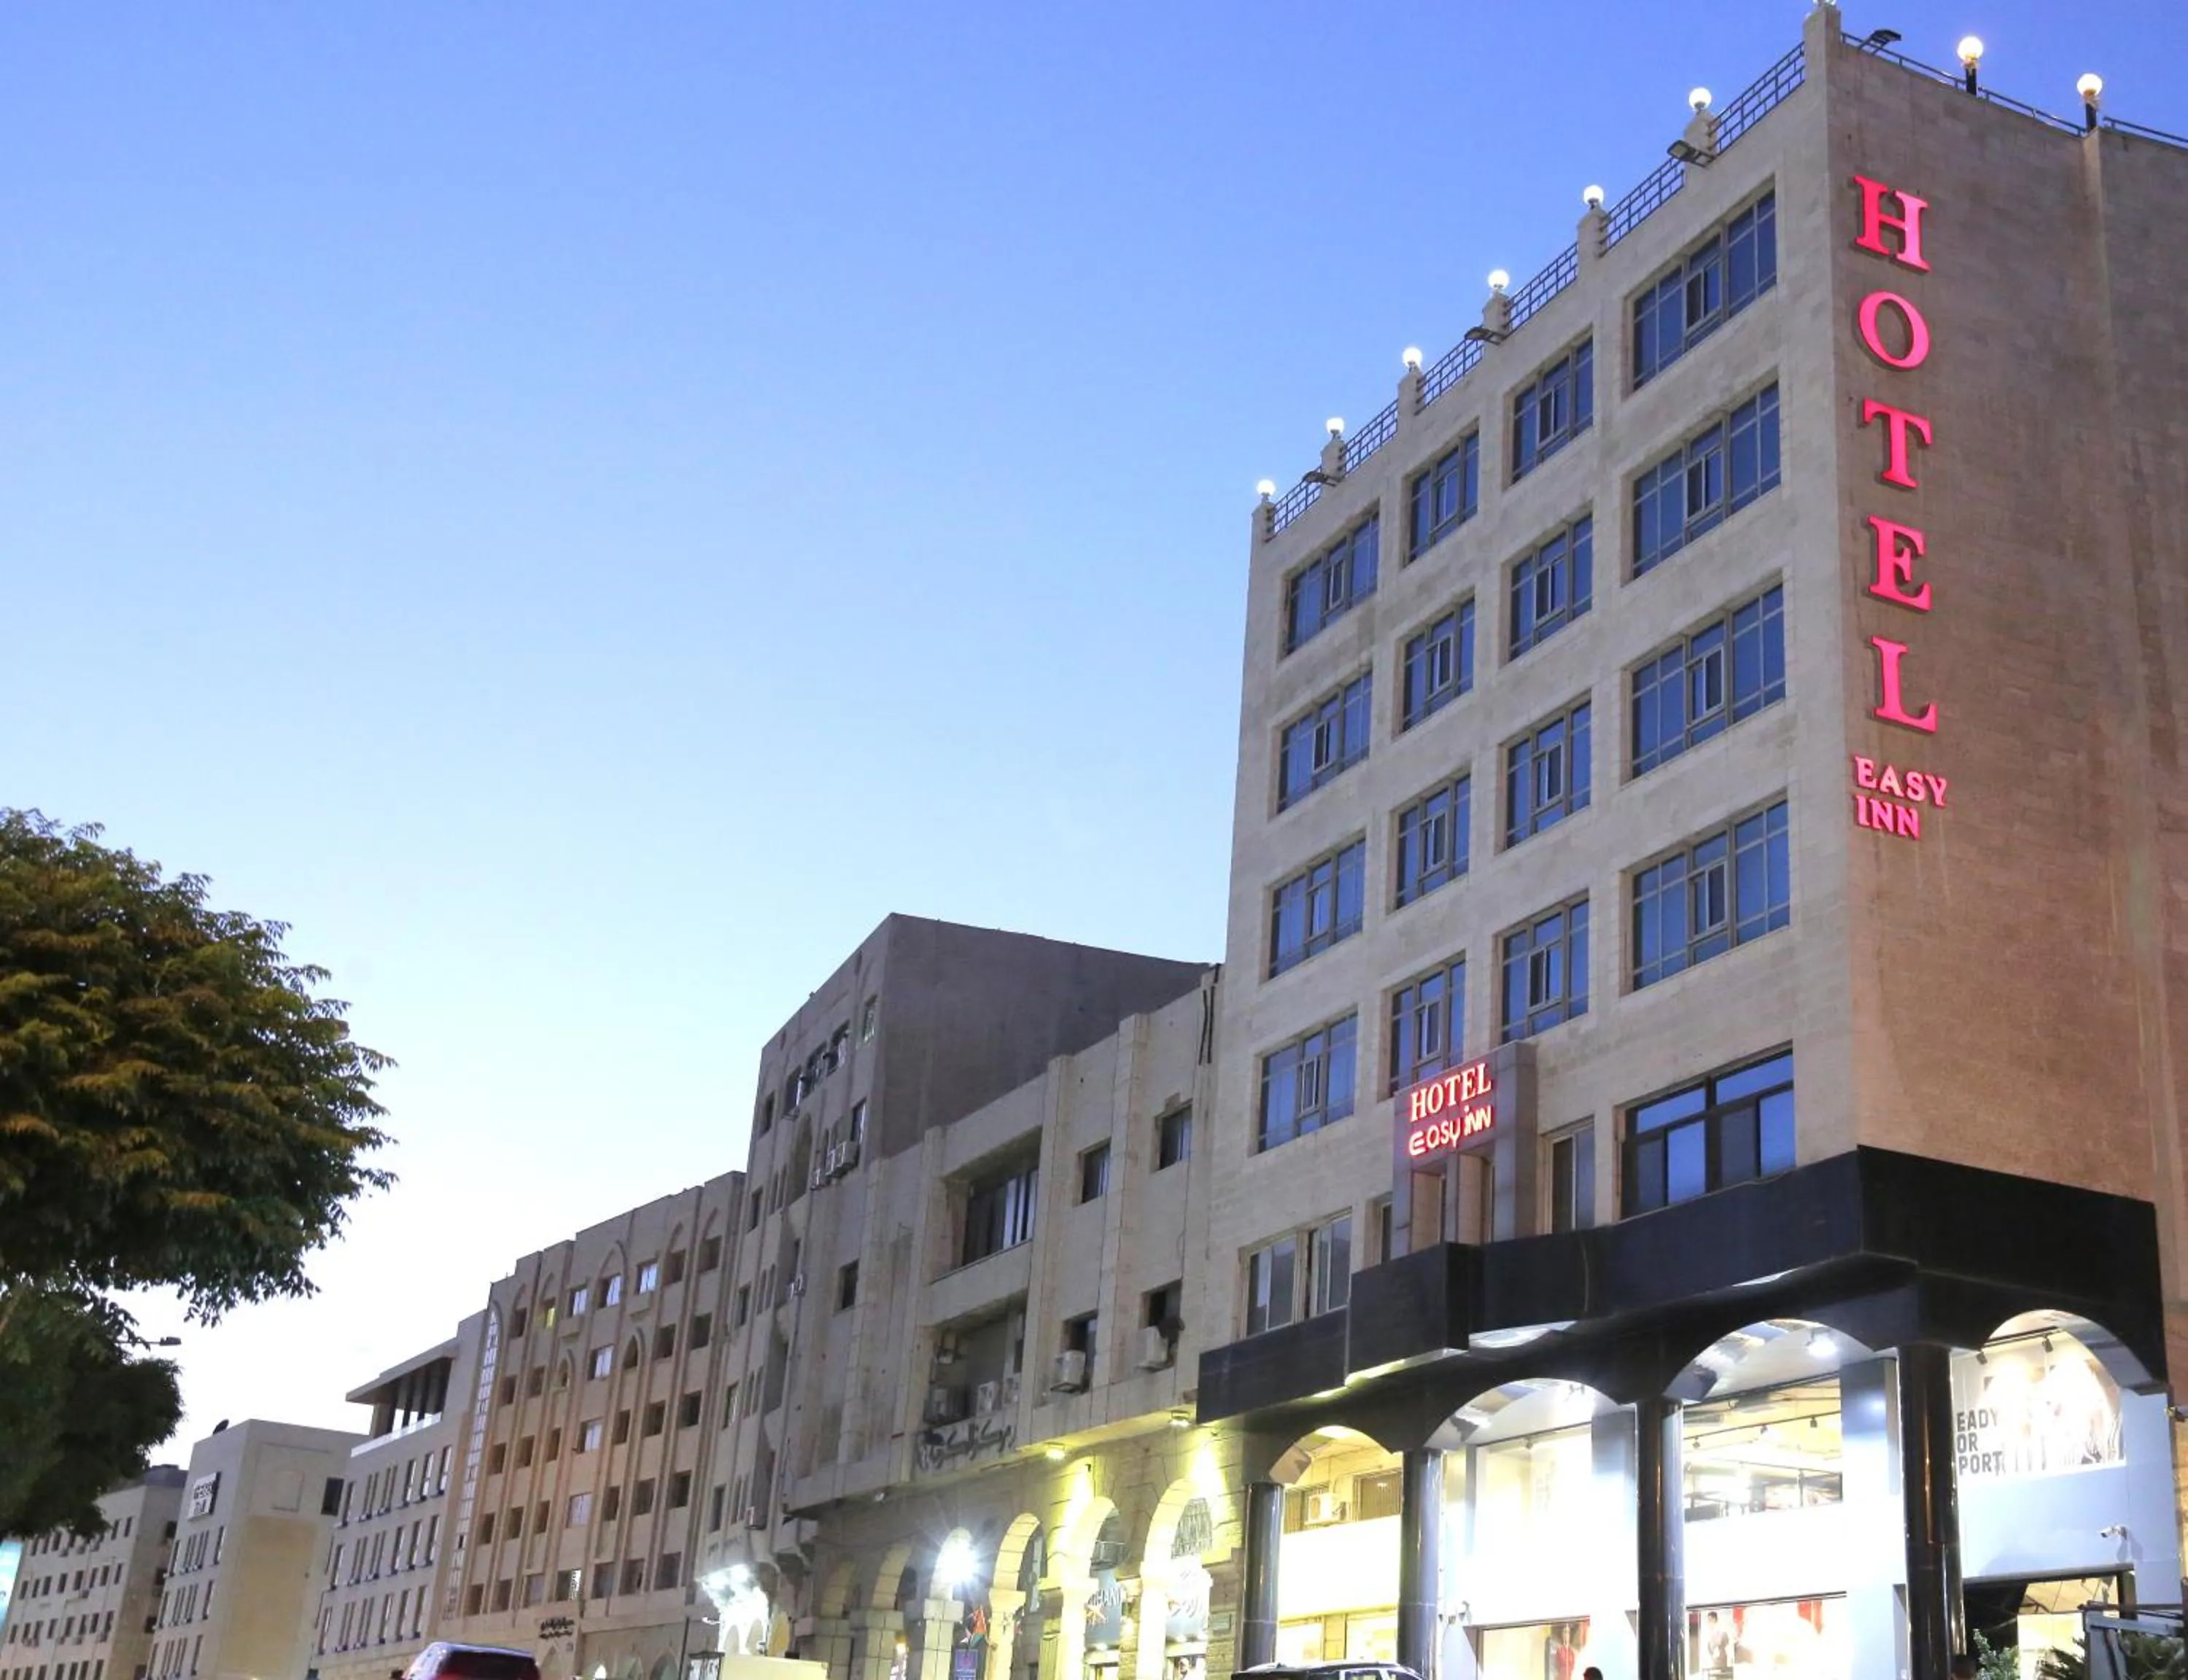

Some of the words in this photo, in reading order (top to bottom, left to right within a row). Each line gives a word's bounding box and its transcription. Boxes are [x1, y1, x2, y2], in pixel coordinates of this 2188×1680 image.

[1855, 175, 1939, 732] HOTEL
[1854, 755, 1947, 806] EASY
[1855, 793, 1920, 840] INN
[1410, 1062, 1492, 1122] HOTEL
[1956, 1407, 1998, 1433] EADY
[1957, 1432, 1979, 1454] OR
[1958, 1451, 2003, 1476] PORT
